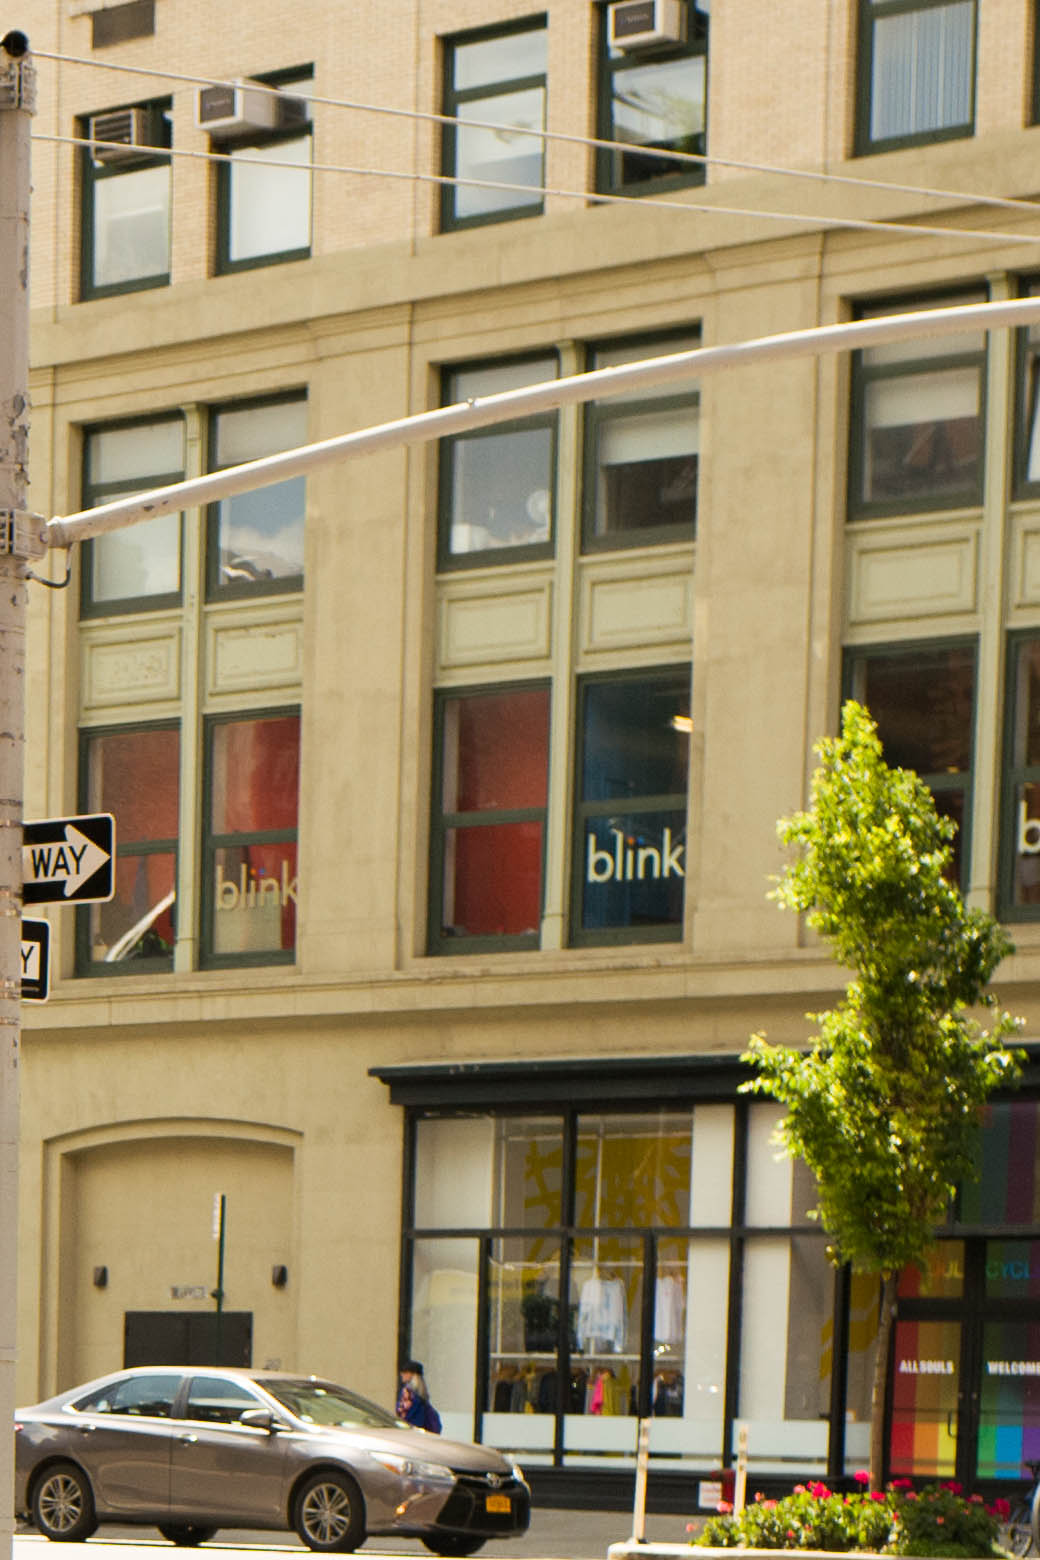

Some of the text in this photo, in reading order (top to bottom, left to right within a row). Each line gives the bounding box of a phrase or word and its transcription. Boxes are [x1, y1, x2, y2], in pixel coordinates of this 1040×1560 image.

[31, 844, 88, 879] WAY
[587, 826, 686, 883] blink
[215, 859, 298, 910] blink
